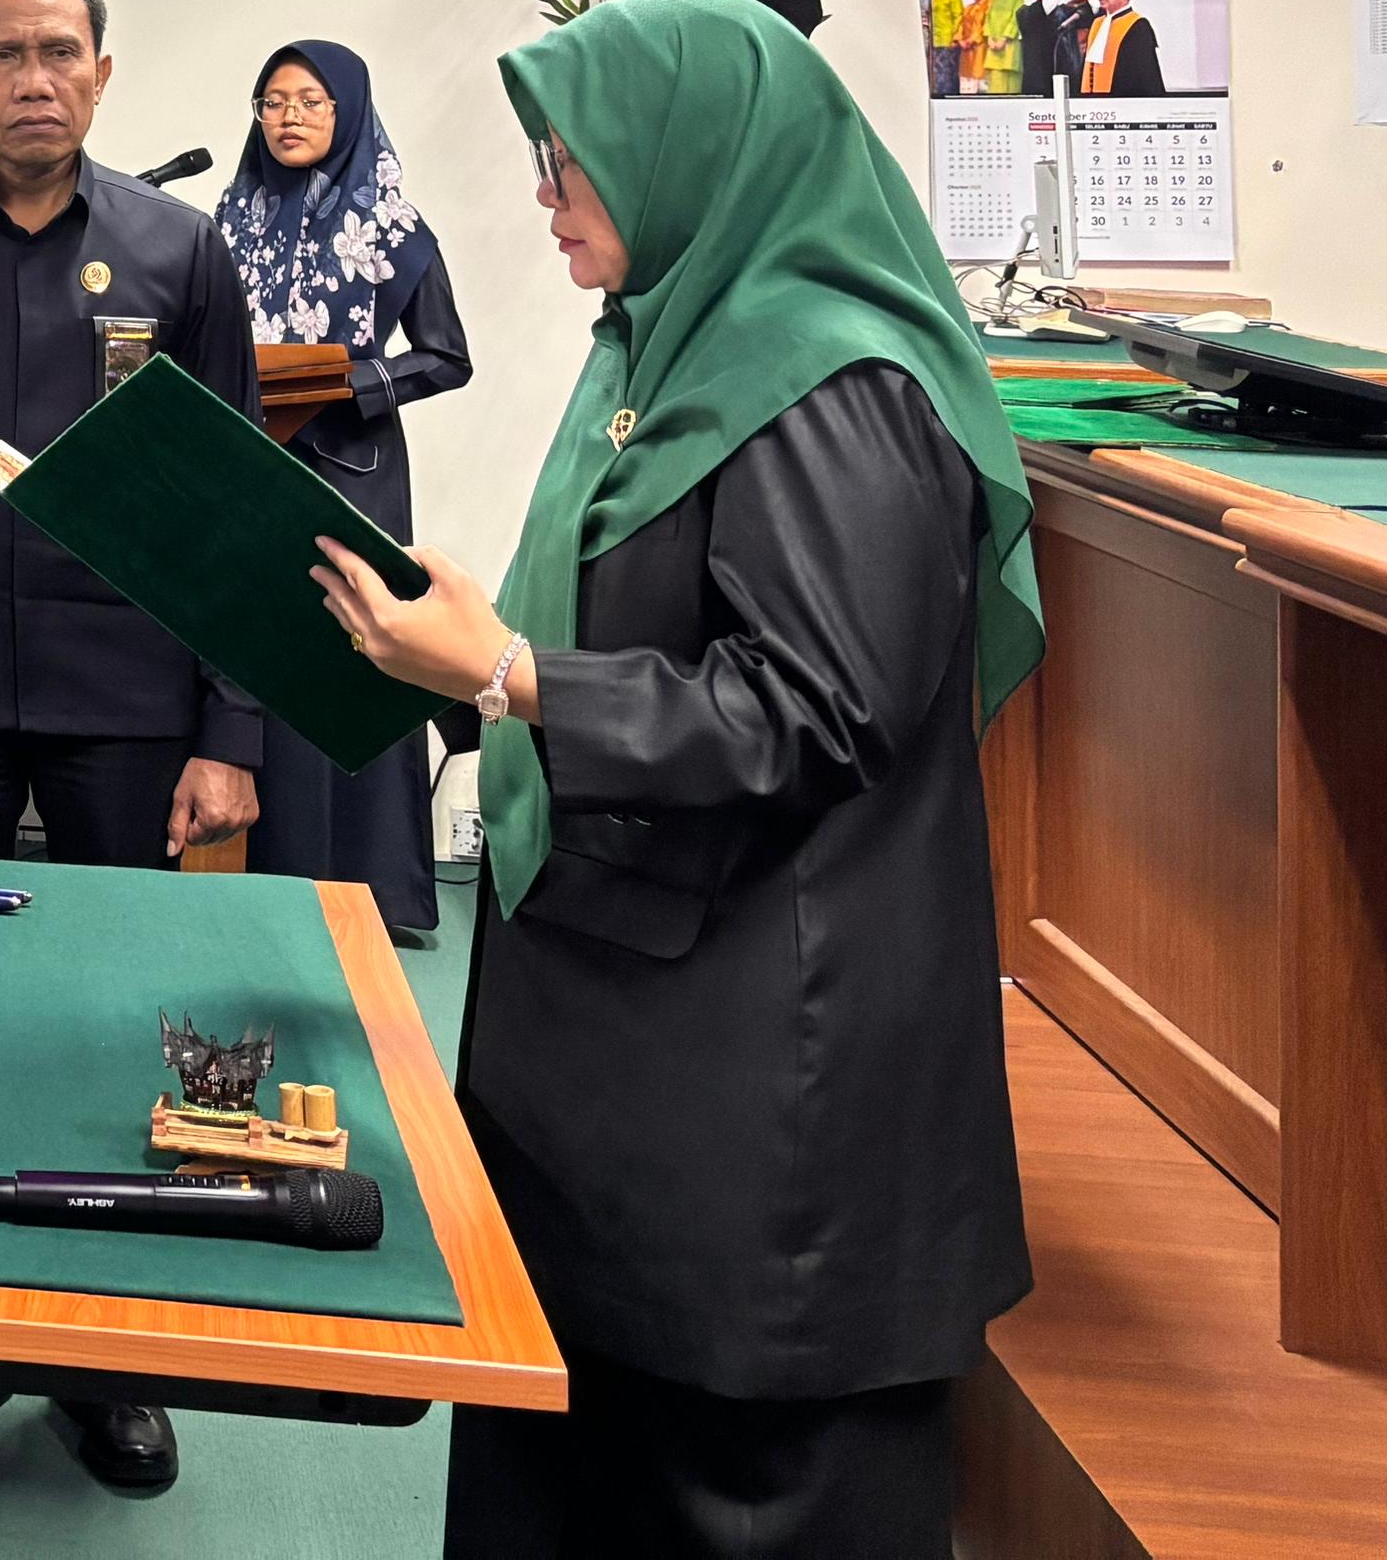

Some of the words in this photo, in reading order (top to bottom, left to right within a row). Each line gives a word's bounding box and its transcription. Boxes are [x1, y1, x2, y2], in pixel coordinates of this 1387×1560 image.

[1089, 111, 1117, 121] 2025
[1035, 135, 1050, 145] 31
[1091, 135, 1100, 145] 2
[1118, 135, 1127, 145] 3
[1145, 135, 1153, 144] 4
[1173, 135, 1180, 144] 5
[1200, 135, 1208, 144] 6
[1092, 155, 1101, 166] 9
[1116, 155, 1131, 165] 10
[1143, 155, 1158, 165] 11
[1170, 155, 1185, 165] 12
[1197, 155, 1213, 165] 13
[1090, 176, 1105, 186] 16
[1117, 175, 1132, 185] 17
[1144, 175, 1159, 185] 18
[1171, 175, 1186, 185] 19
[1197, 175, 1214, 185] 20
[1090, 196, 1106, 206] 23
[1117, 196, 1132, 206] 24
[1144, 196, 1159, 206] 25
[1171, 196, 1187, 206] 26
[1198, 196, 1214, 206] 27
[1091, 216, 1106, 226] 30
[1122, 216, 1129, 226] 1
[1148, 216, 1157, 226] 2
[1175, 216, 1184, 226] 3
[1202, 216, 1211, 226] 4
